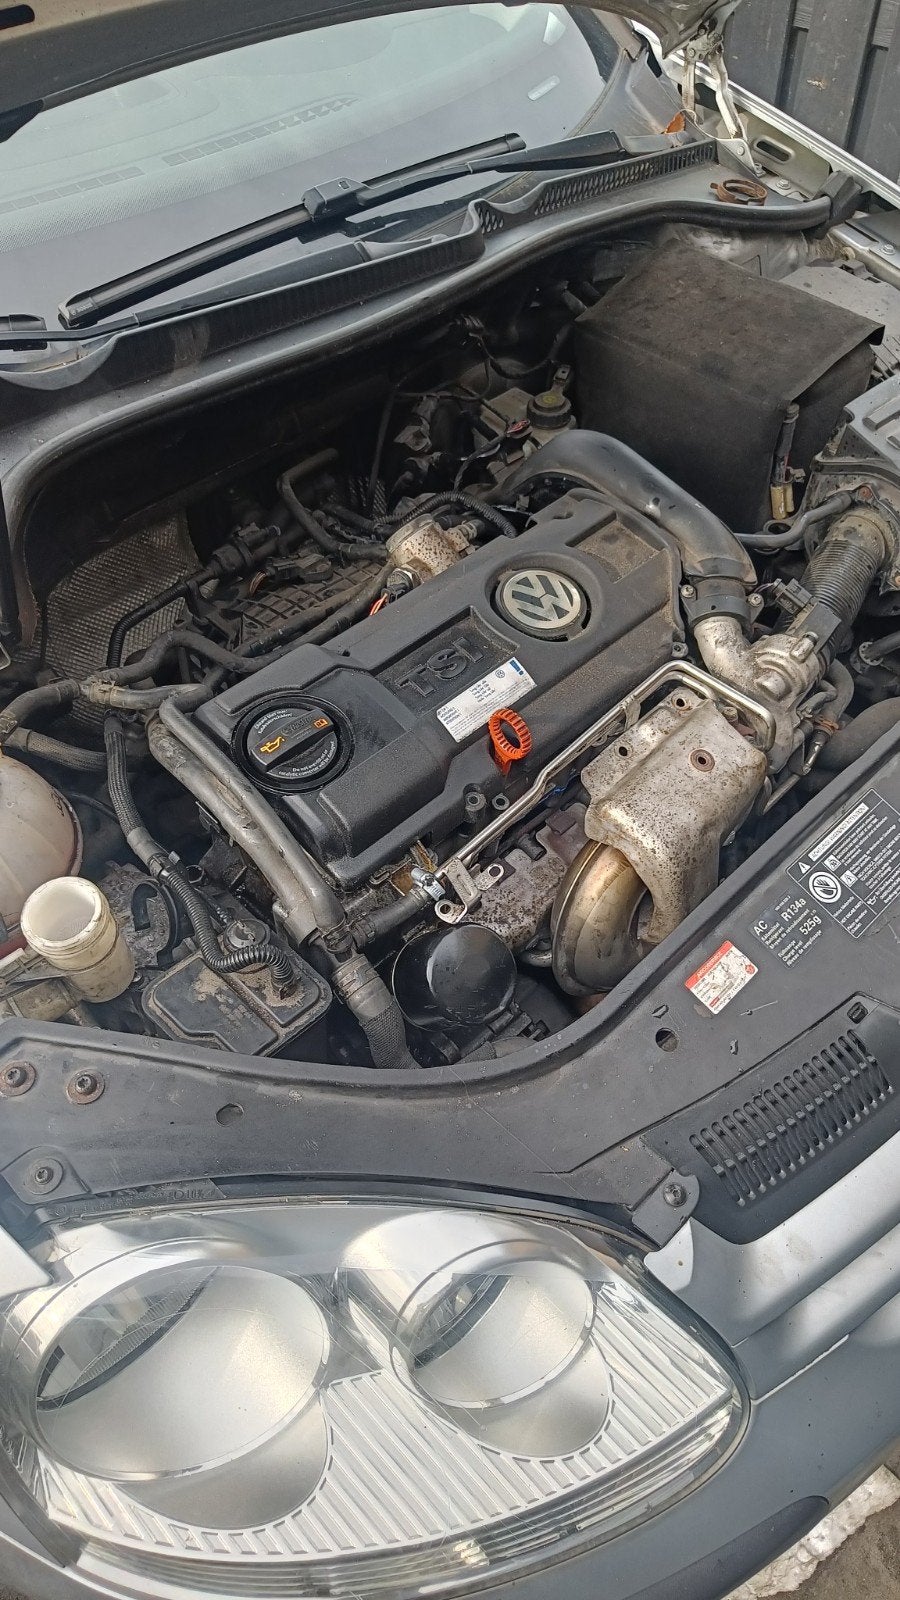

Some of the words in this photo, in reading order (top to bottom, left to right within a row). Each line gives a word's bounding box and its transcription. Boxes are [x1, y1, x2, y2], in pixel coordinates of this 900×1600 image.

[396, 637, 484, 697] TSI
[781, 898, 806, 921] R134a
[754, 920, 768, 936] AC
[800, 916, 821, 935] 525g
